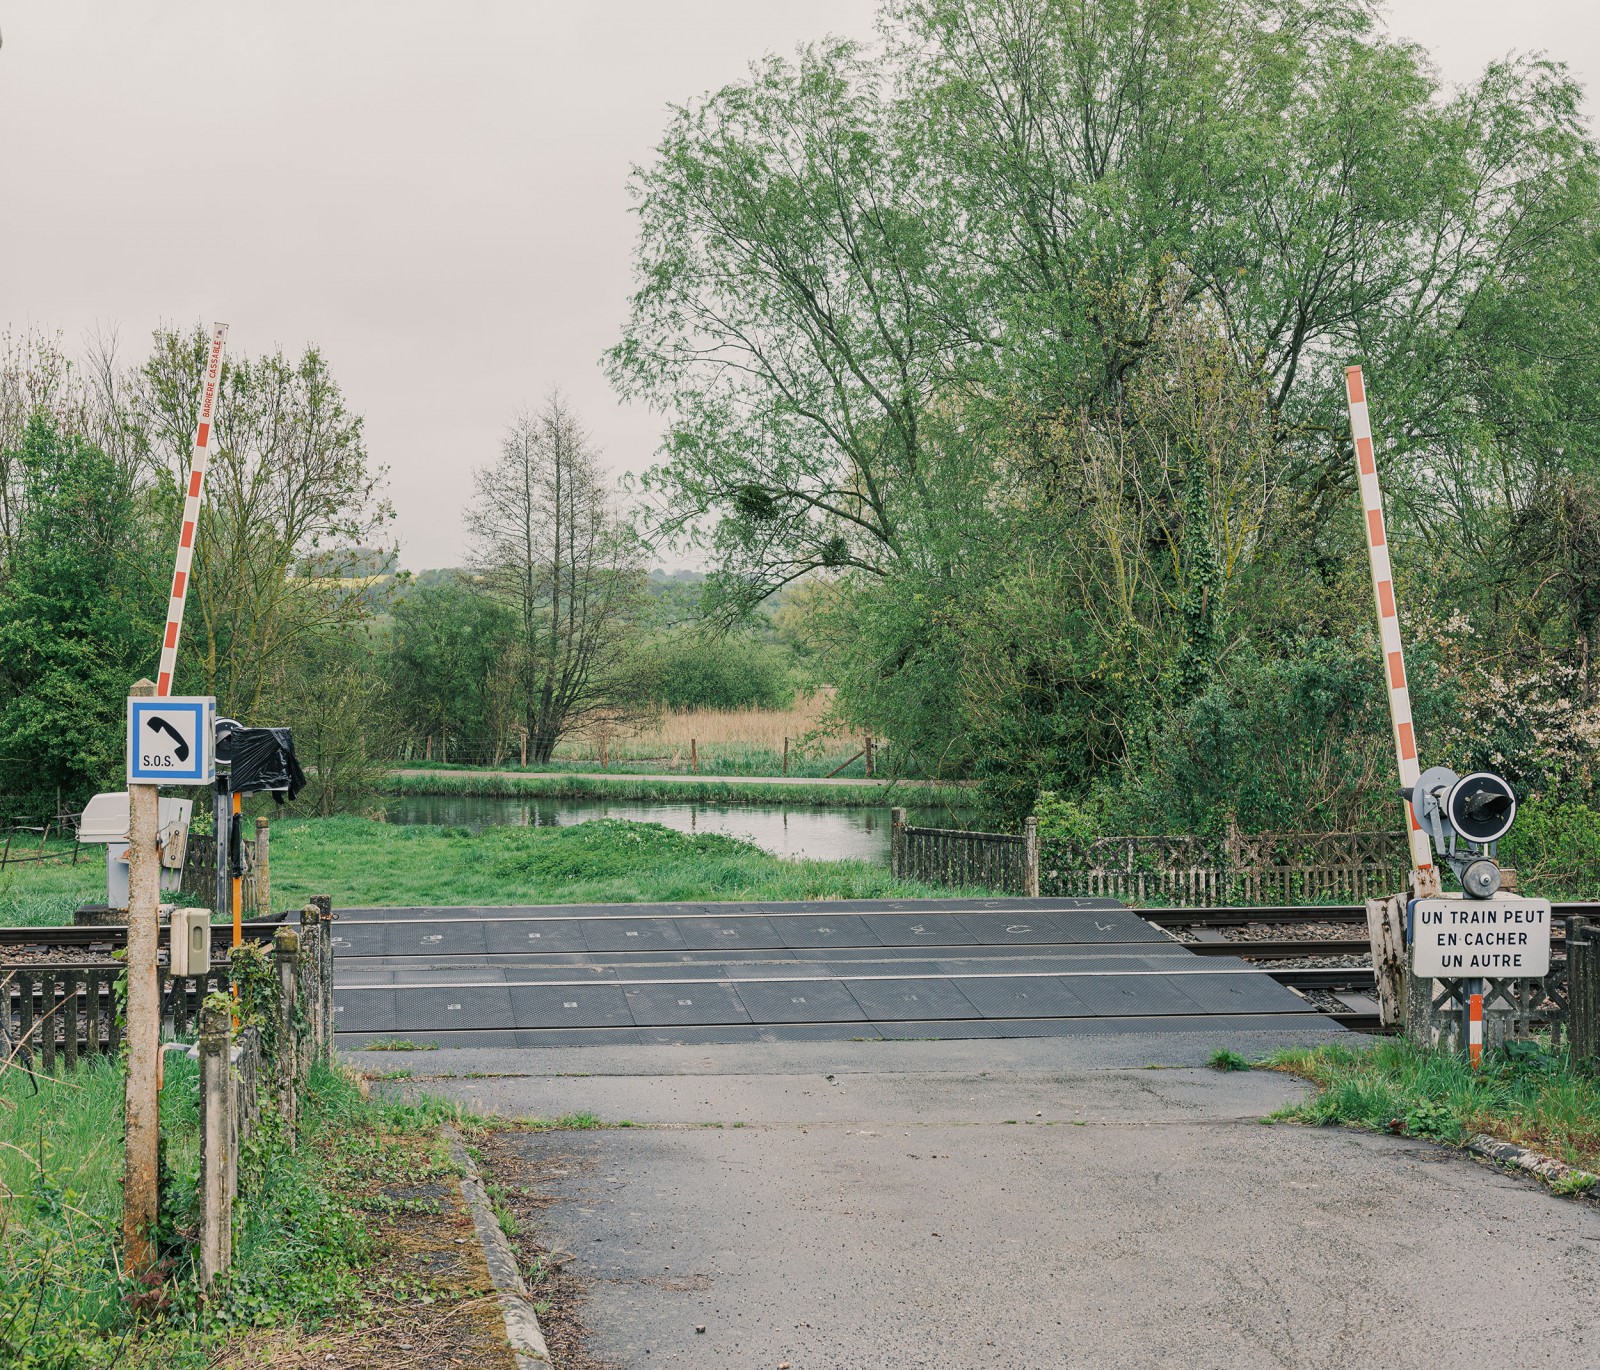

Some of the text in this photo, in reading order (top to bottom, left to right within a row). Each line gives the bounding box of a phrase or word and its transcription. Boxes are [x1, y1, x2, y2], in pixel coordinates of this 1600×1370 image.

[203, 340, 221, 417] BARRIERE CASSABLE
[143, 755, 174, 767] S.O.S.
[1421, 910, 1545, 924] UN TRAIN PEUT
[1437, 932, 1528, 946] EN CACHER
[1441, 954, 1522, 968] UN AUTRE
